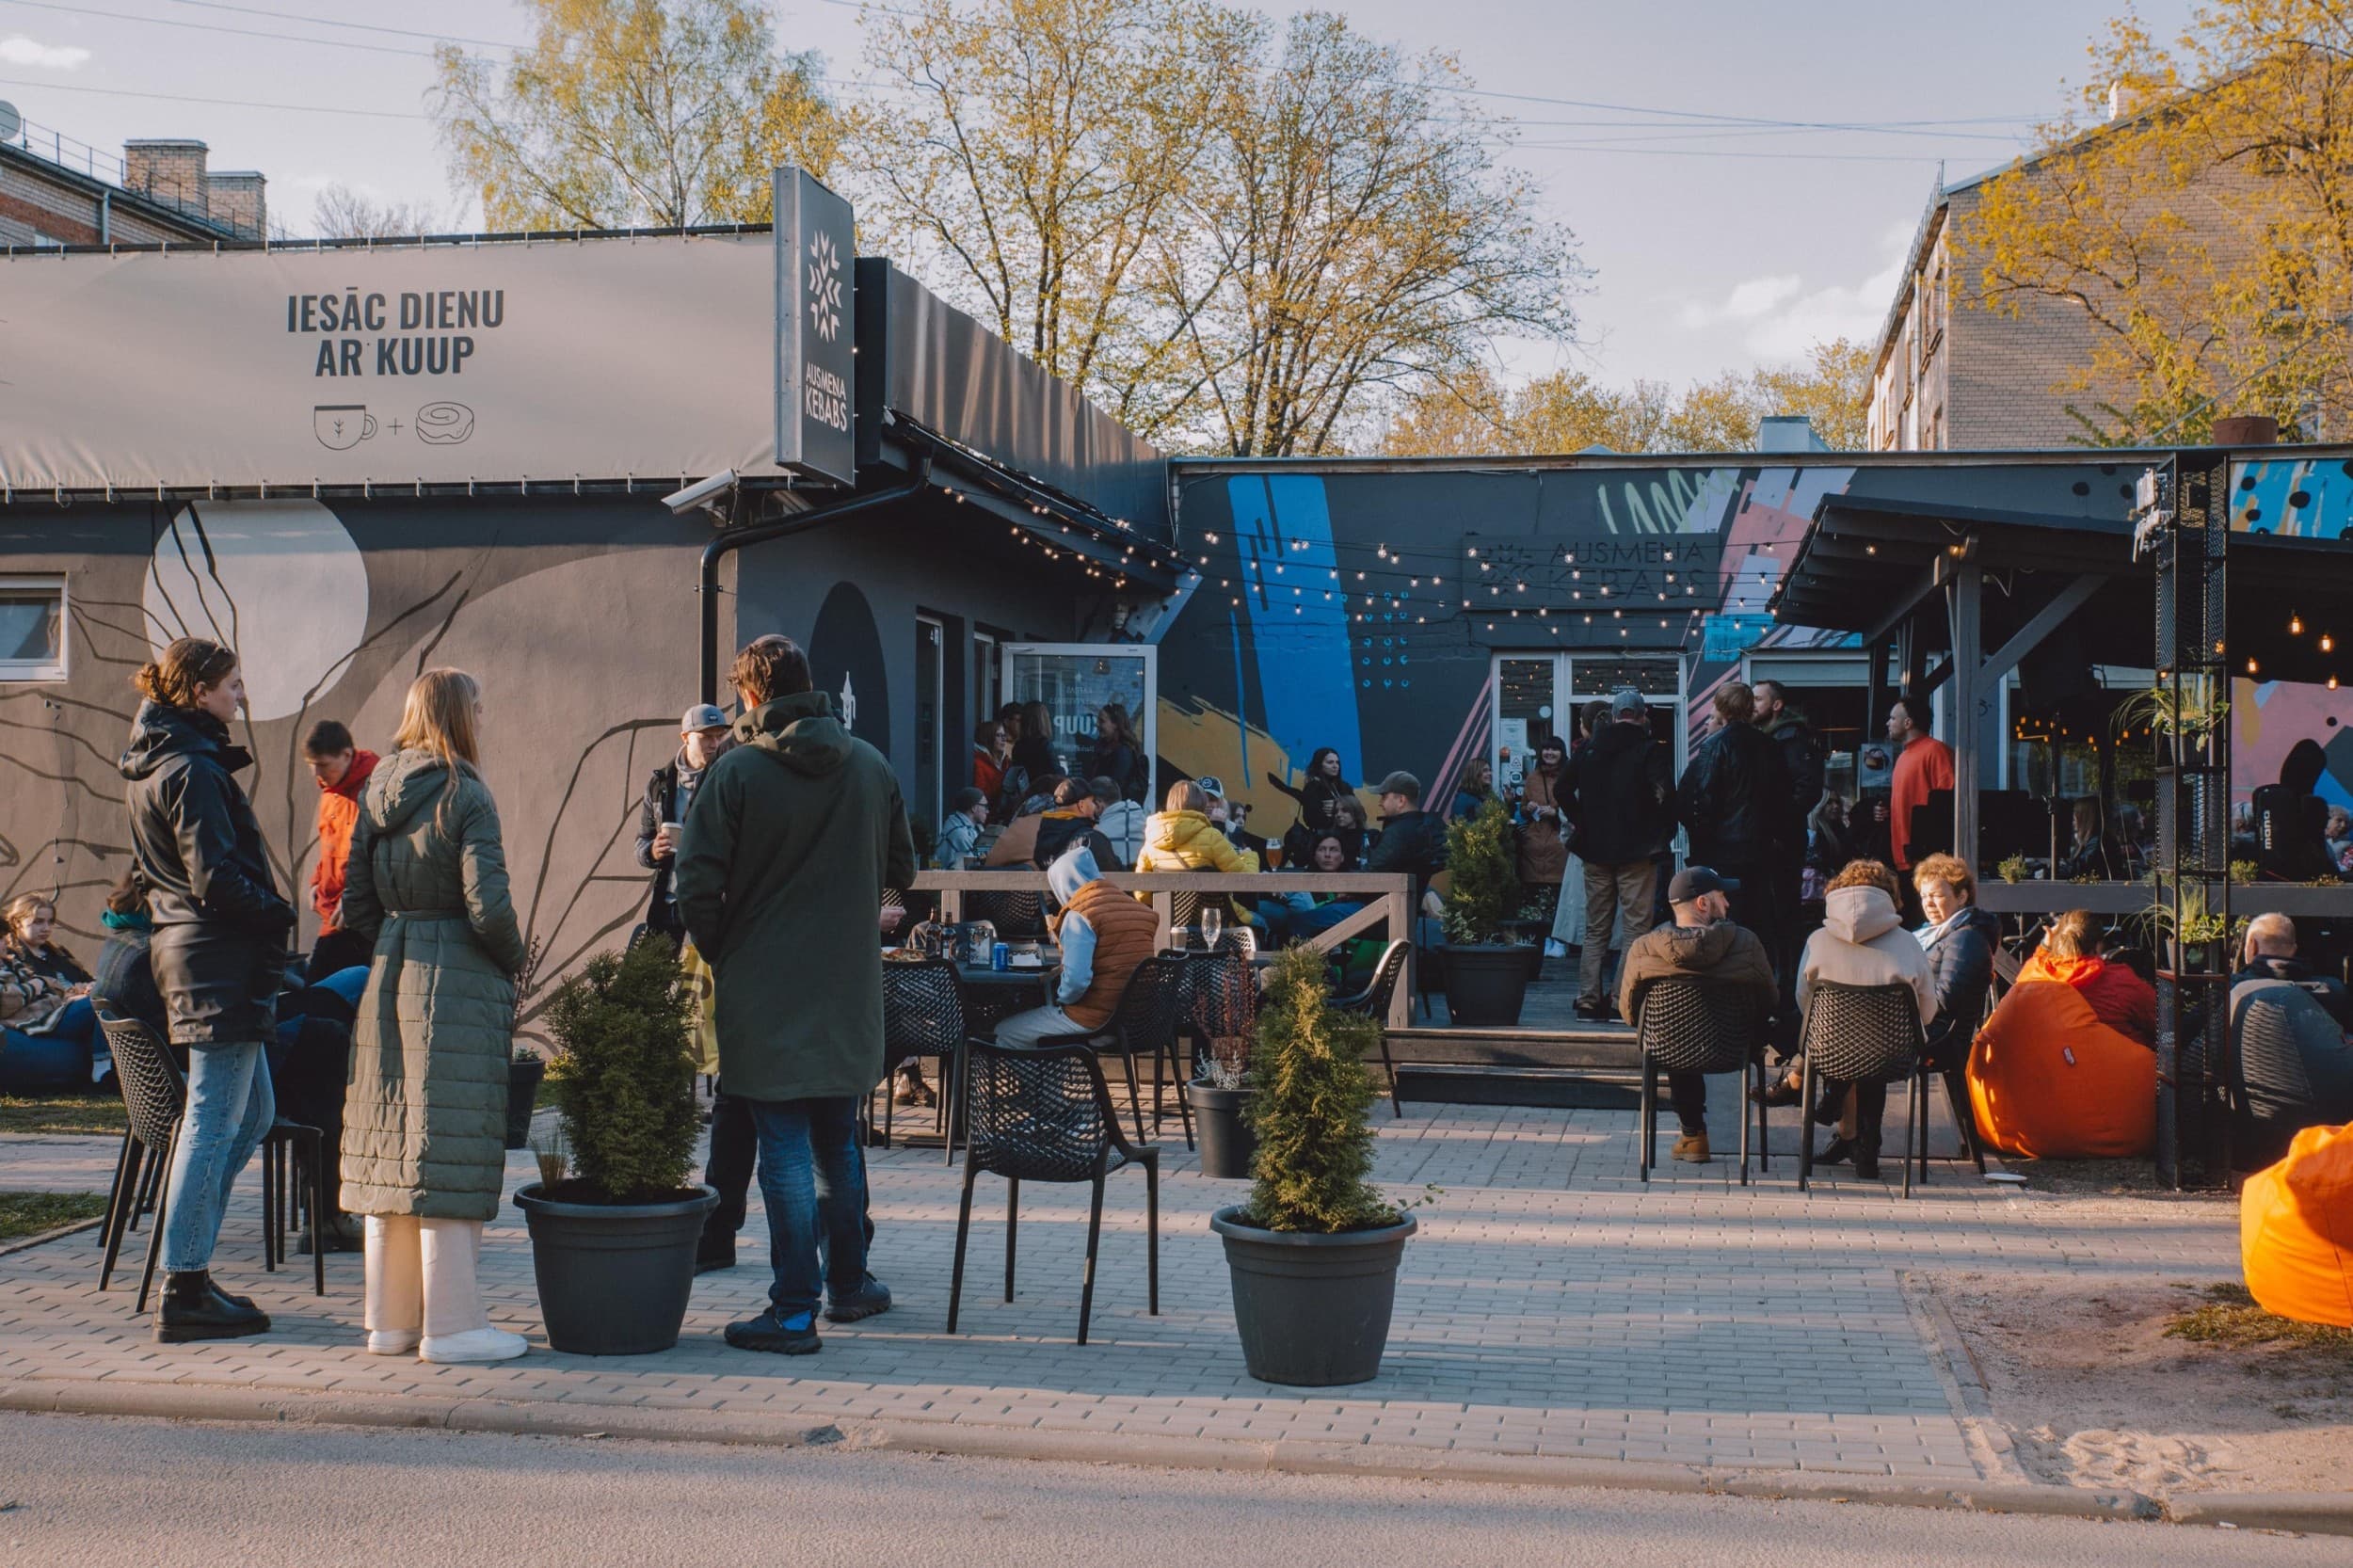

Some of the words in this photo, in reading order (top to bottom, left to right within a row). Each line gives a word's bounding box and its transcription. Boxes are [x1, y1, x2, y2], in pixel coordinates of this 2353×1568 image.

[287, 286, 386, 332] IESĀC
[400, 290, 504, 330] DIENU
[315, 339, 362, 376] AR
[376, 336, 474, 376] KUUP
[806, 361, 846, 401] AUSMENA
[806, 384, 847, 432] KEBABS
[1550, 541, 1706, 563] AUSMENA
